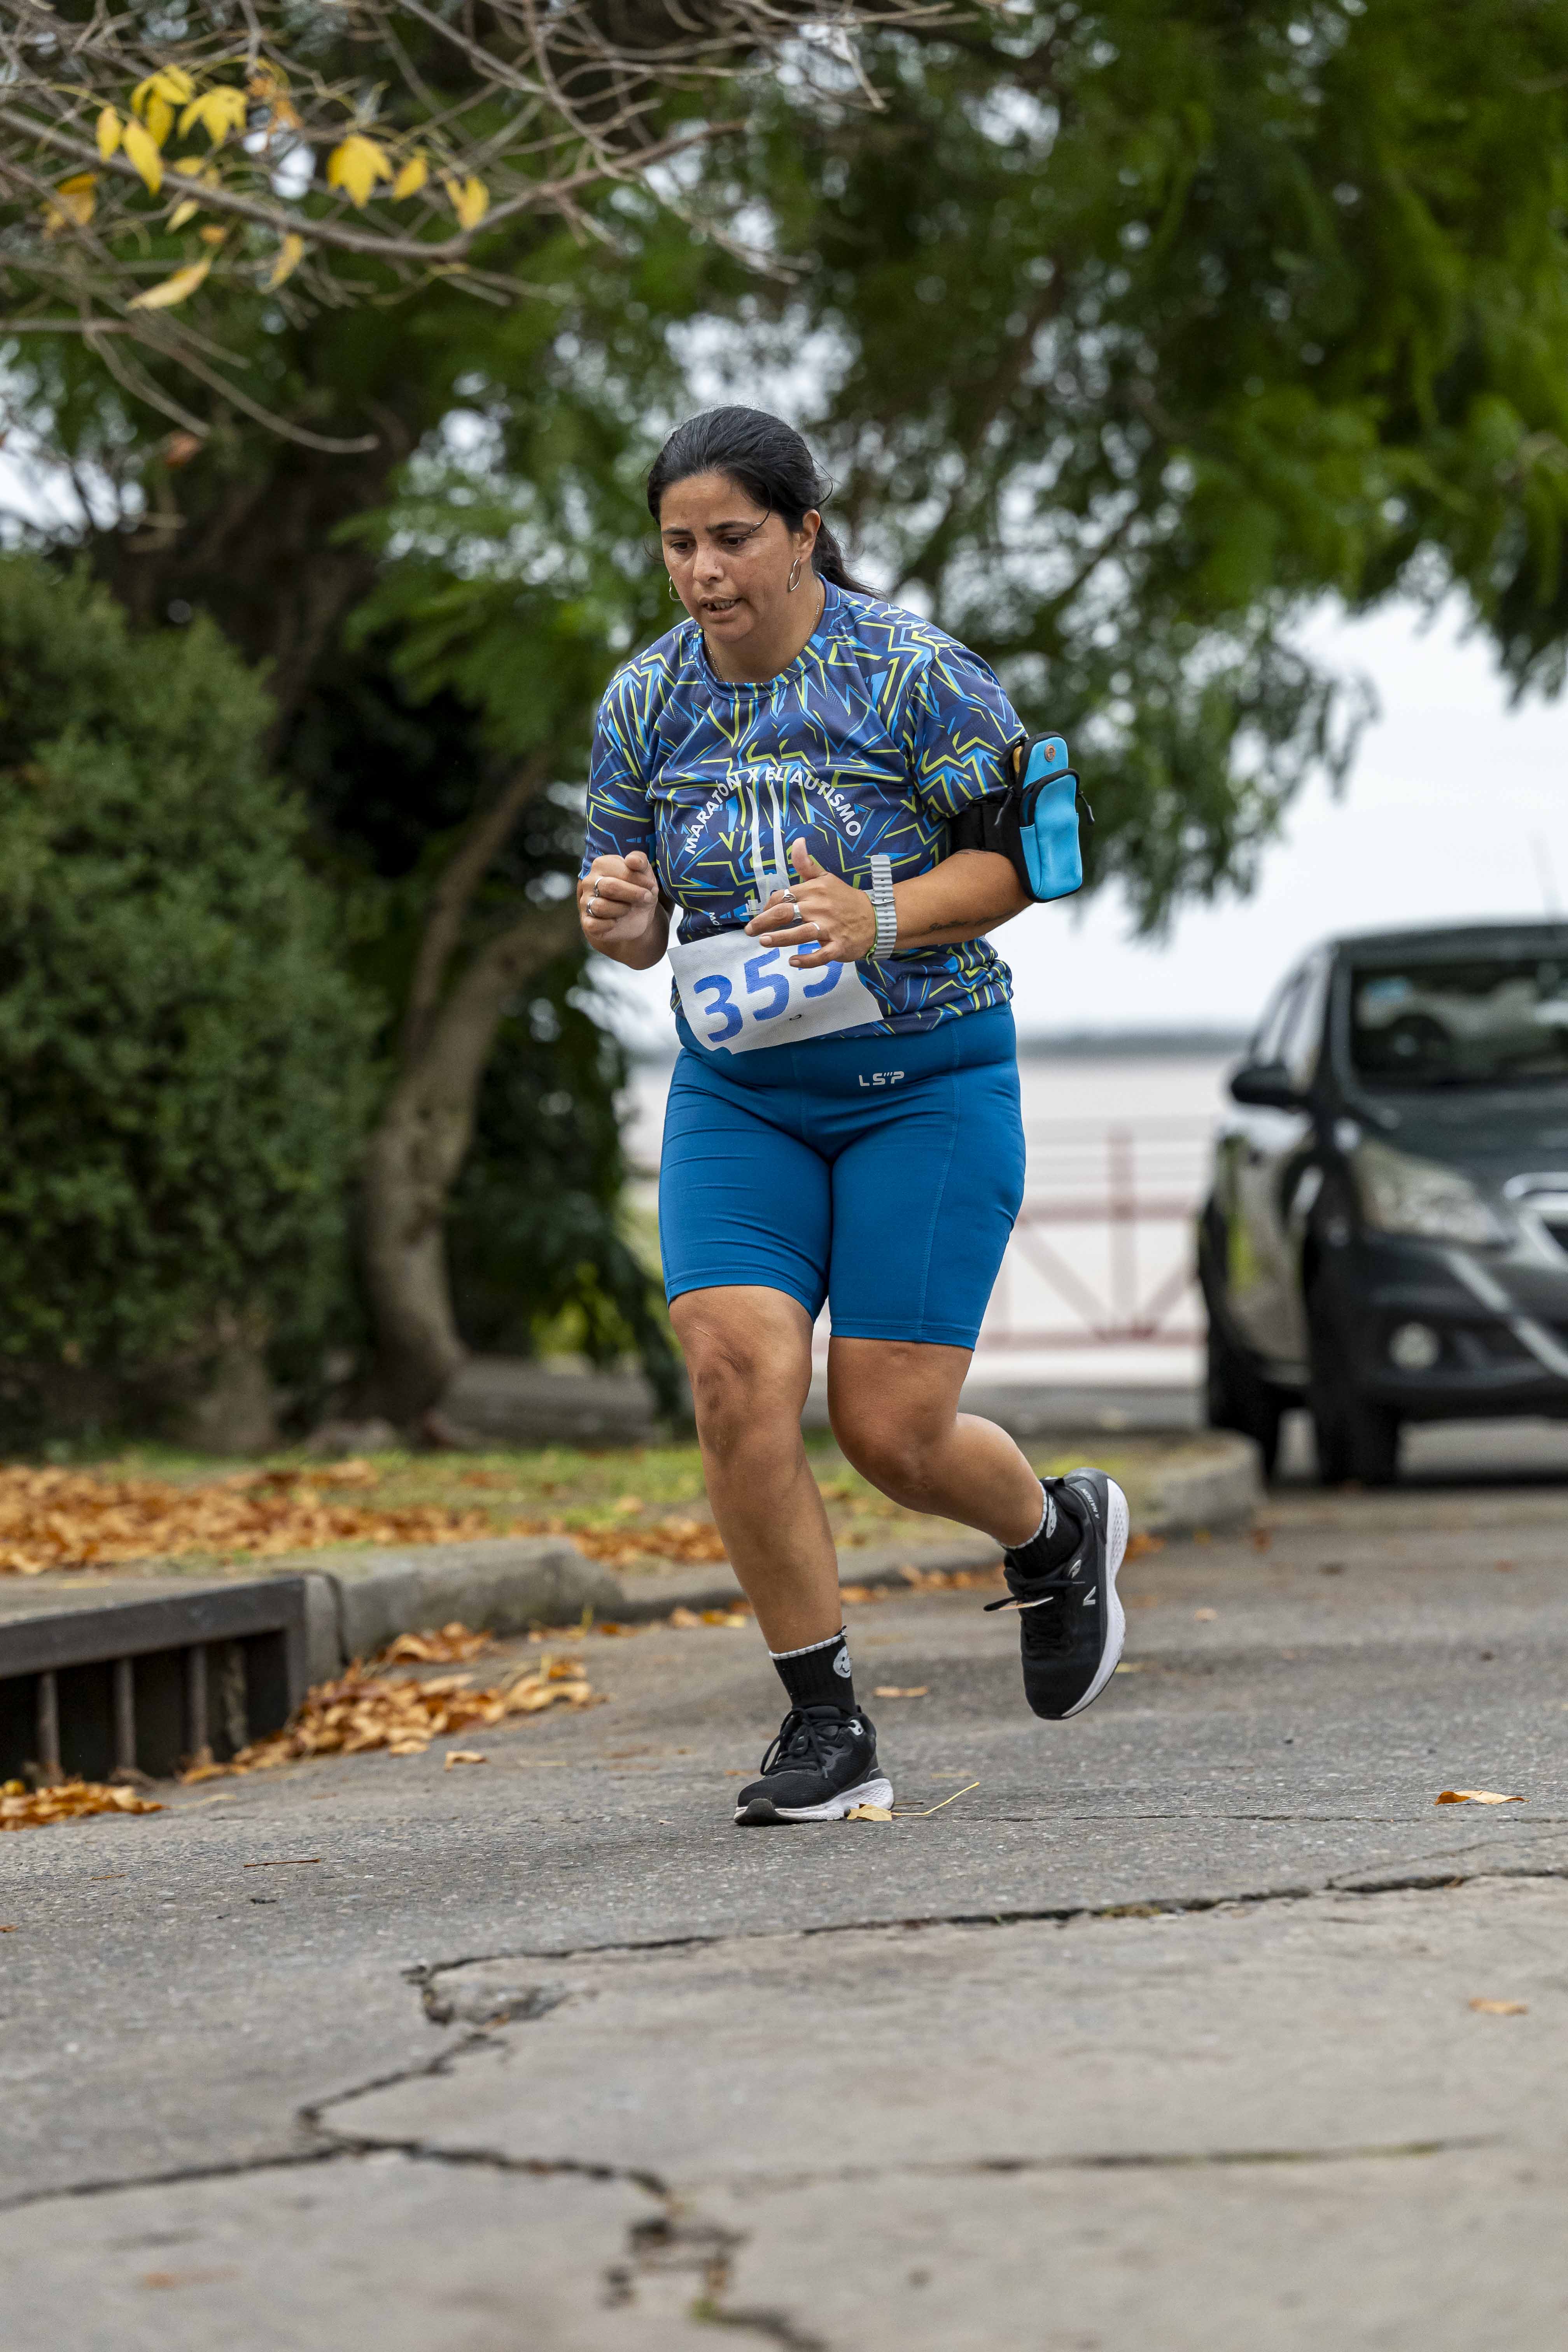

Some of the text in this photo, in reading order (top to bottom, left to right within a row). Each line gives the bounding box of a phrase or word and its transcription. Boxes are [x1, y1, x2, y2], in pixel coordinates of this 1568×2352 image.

[685, 767, 861, 855] MARATÓN X EL AUTISMO
